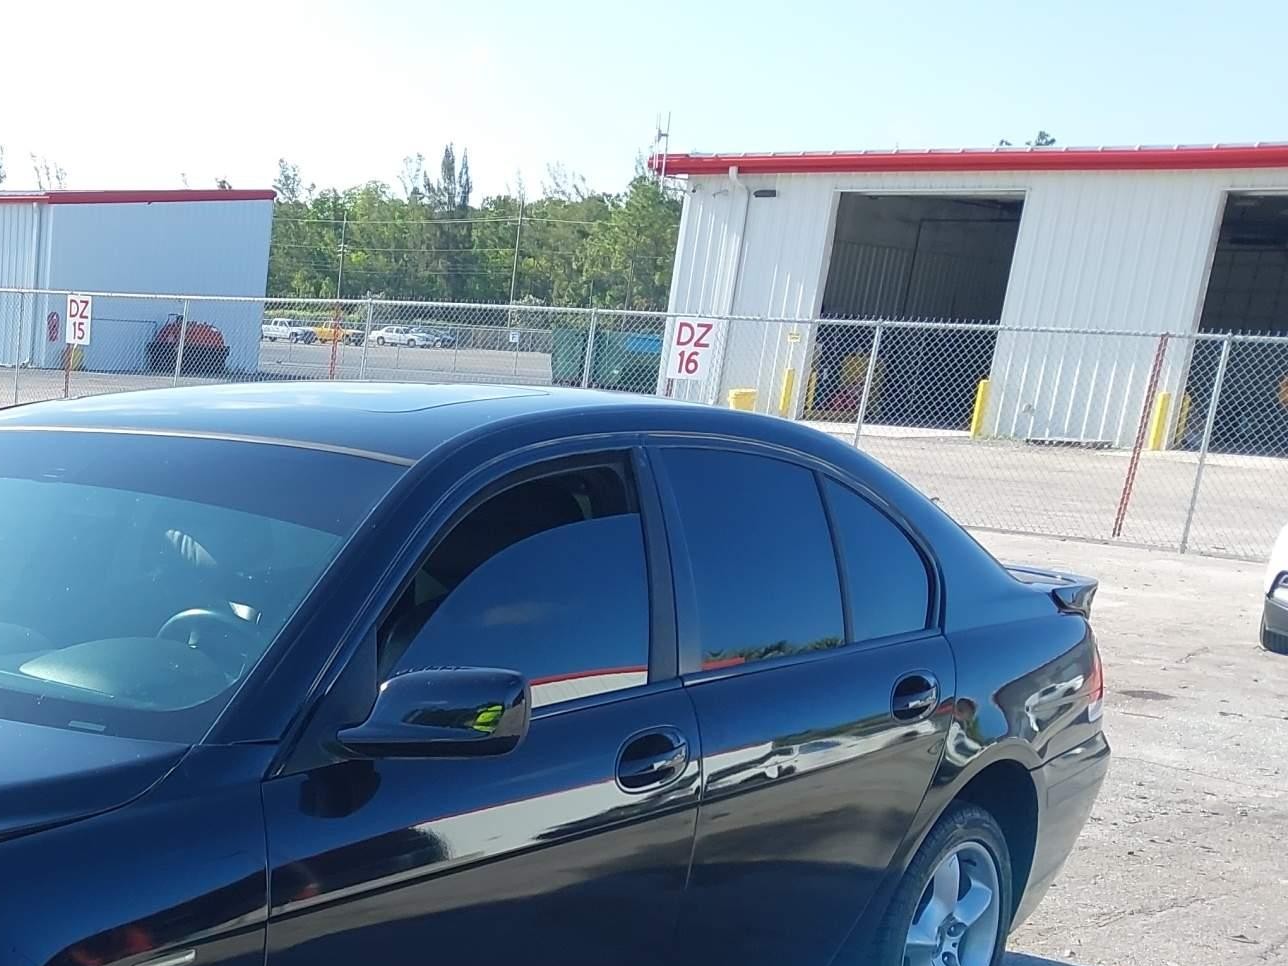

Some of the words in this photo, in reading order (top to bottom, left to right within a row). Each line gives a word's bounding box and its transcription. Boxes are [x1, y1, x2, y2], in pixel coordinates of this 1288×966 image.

[69, 299, 89, 319] DZ
[72, 320, 85, 340] 15
[676, 321, 713, 348] DZ
[677, 350, 700, 374] 16
